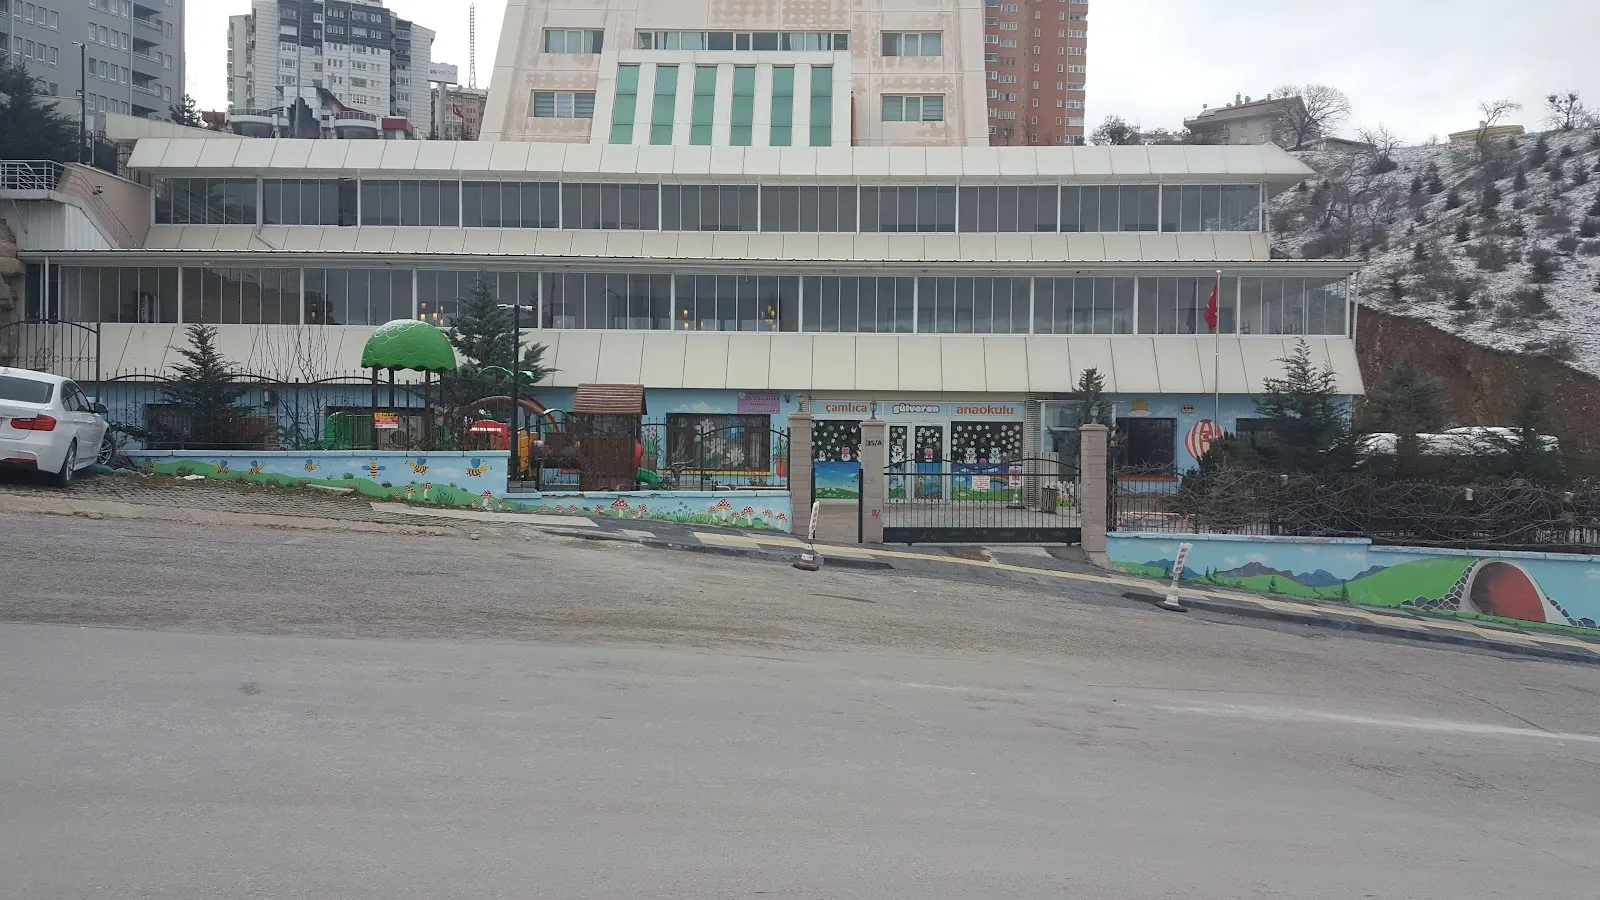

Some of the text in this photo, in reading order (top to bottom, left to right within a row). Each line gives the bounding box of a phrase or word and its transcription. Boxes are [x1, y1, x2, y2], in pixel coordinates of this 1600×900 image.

[825, 403, 1014, 414] çamlıca gülveren anaokulu
